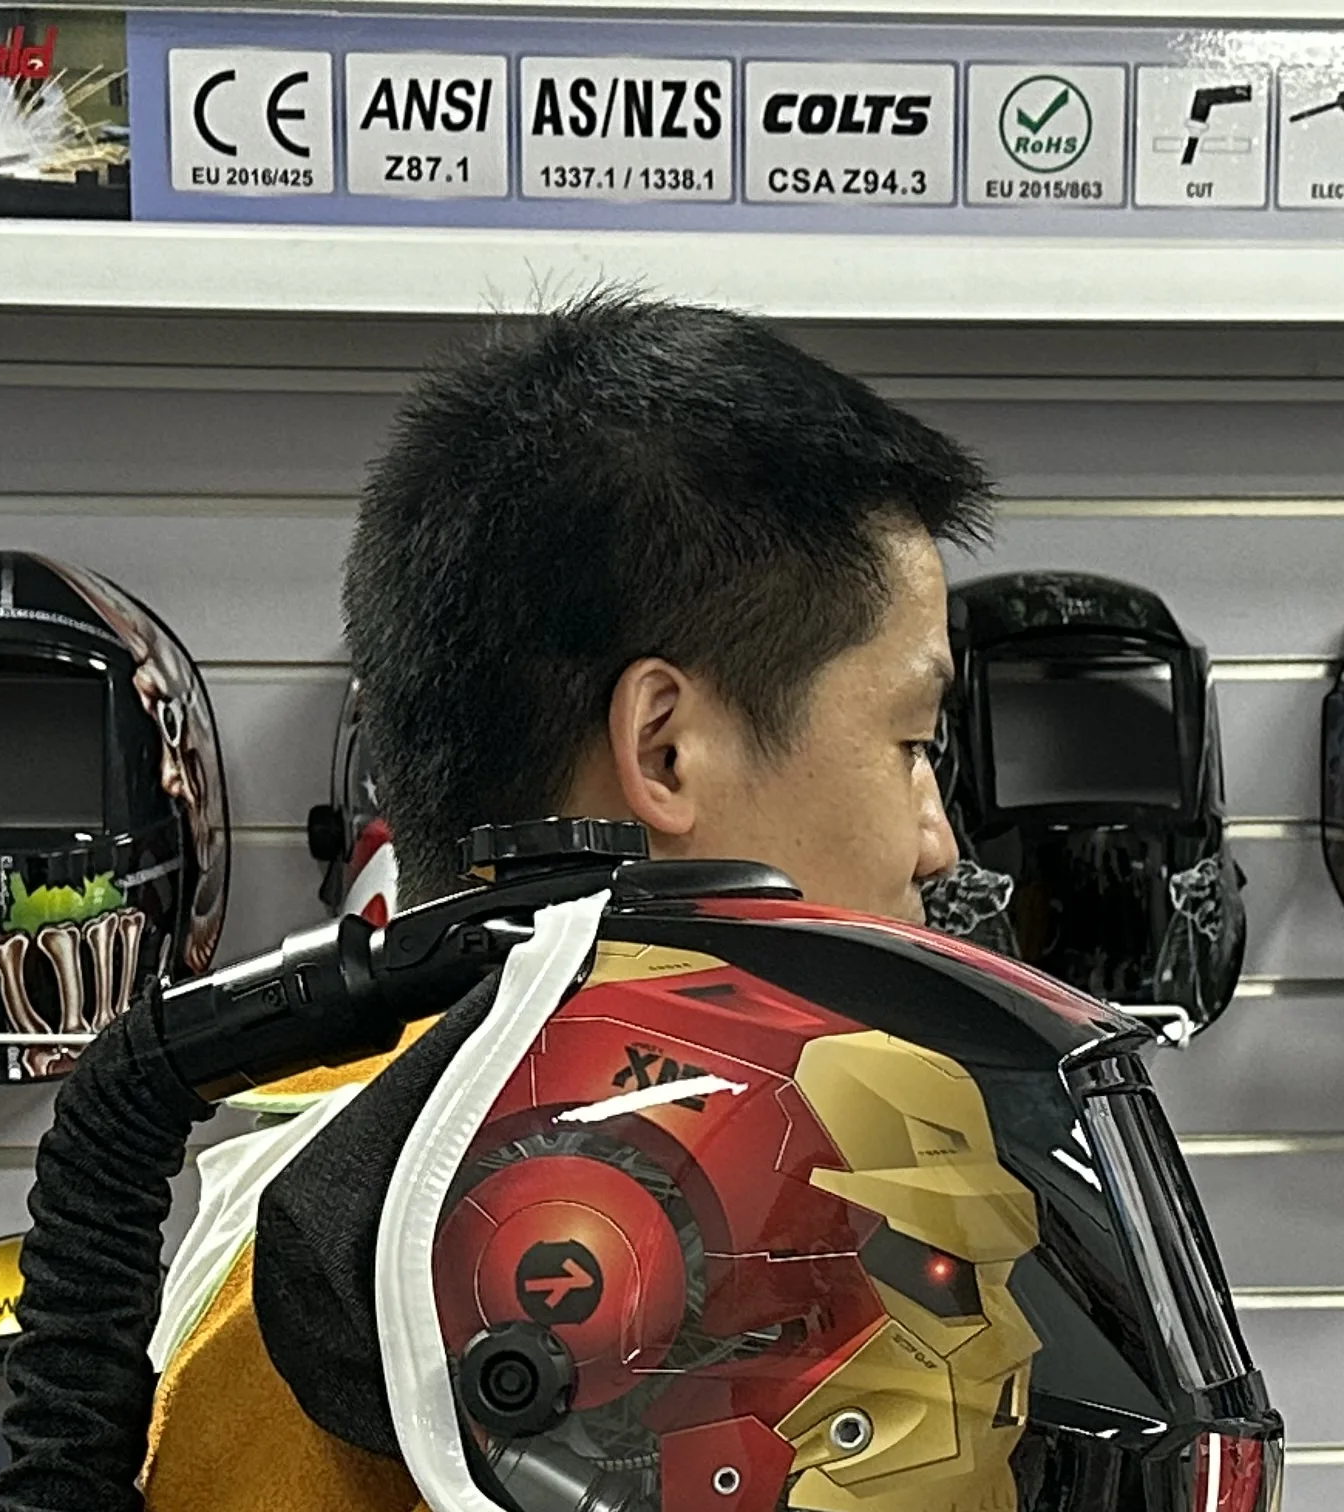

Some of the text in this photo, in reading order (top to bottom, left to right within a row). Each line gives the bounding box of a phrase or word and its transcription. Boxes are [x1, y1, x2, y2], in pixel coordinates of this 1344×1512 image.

[194, 69, 310, 157] CE
[360, 78, 493, 132] ANSI
[532, 77, 723, 139] AS/NZS
[762, 93, 932, 134] COLTS
[1016, 136, 1078, 155] RoHS
[192, 167, 314, 187] EU 2016/425
[385, 156, 469, 182] Z87.1
[540, 167, 616, 188] 1337.1
[640, 168, 714, 190] 1338.1
[768, 169, 927, 195] CSA Z94.3
[986, 180, 1102, 199] EU 2015/863
[1186, 181, 1213, 198] CUT
